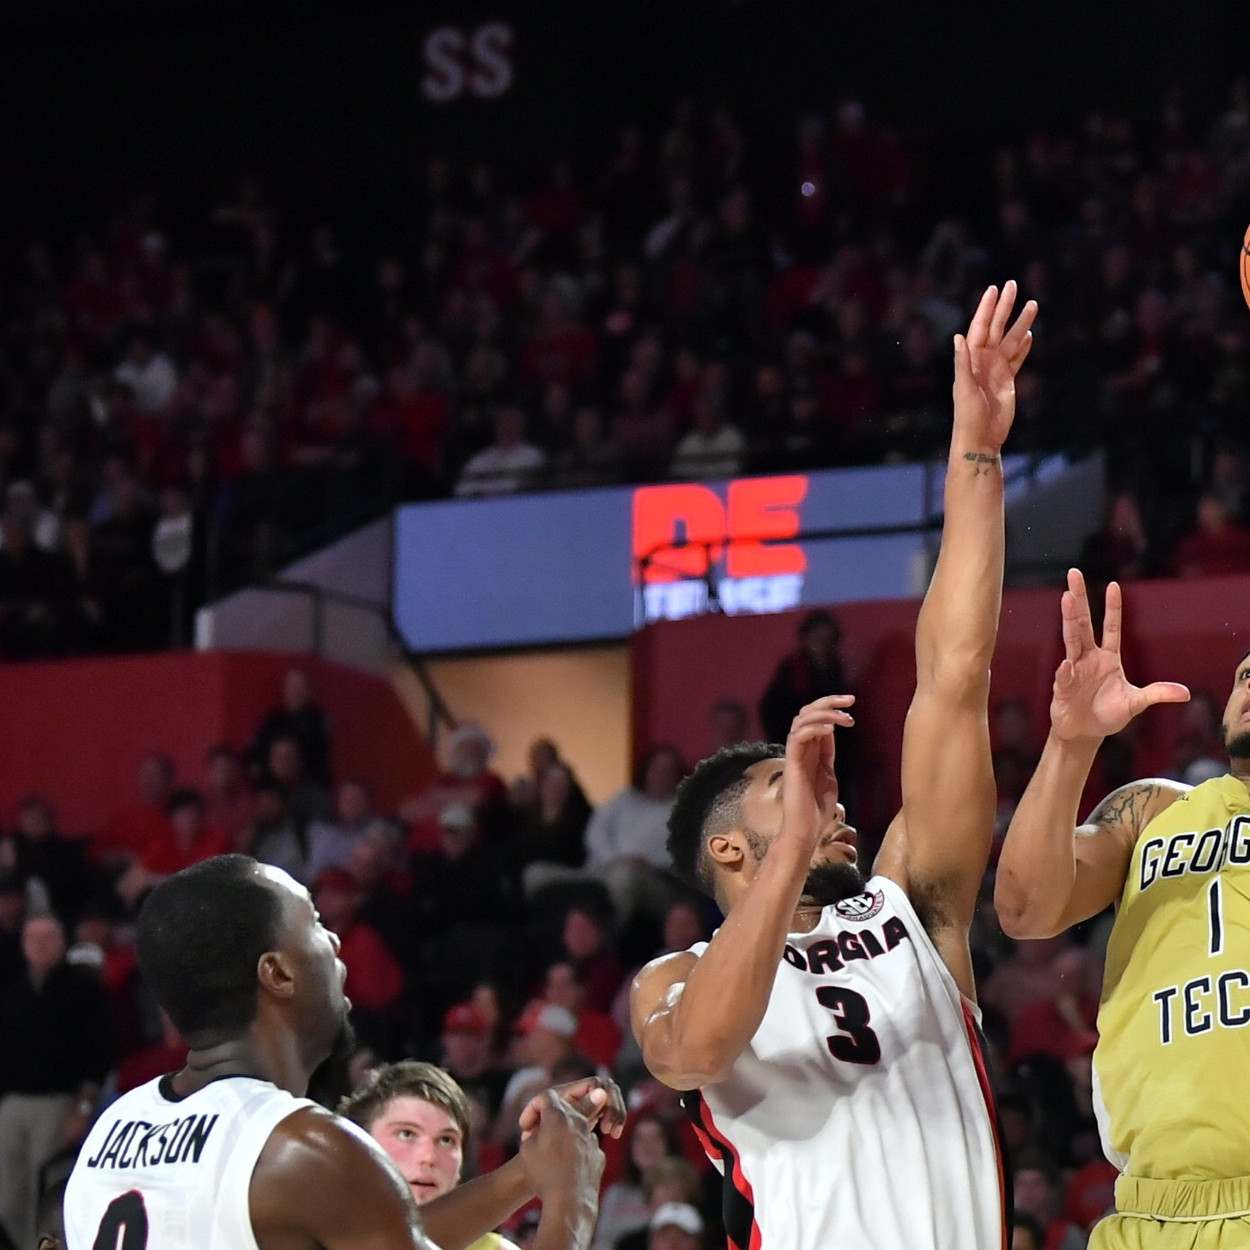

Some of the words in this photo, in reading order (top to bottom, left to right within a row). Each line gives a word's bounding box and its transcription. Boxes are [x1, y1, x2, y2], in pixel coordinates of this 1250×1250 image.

[424, 25, 512, 101] SS
[783, 915, 910, 975] ORGIA
[1207, 874, 1224, 957] 1
[815, 986, 882, 1066] 3
[87, 1113, 220, 1169] JACKSON
